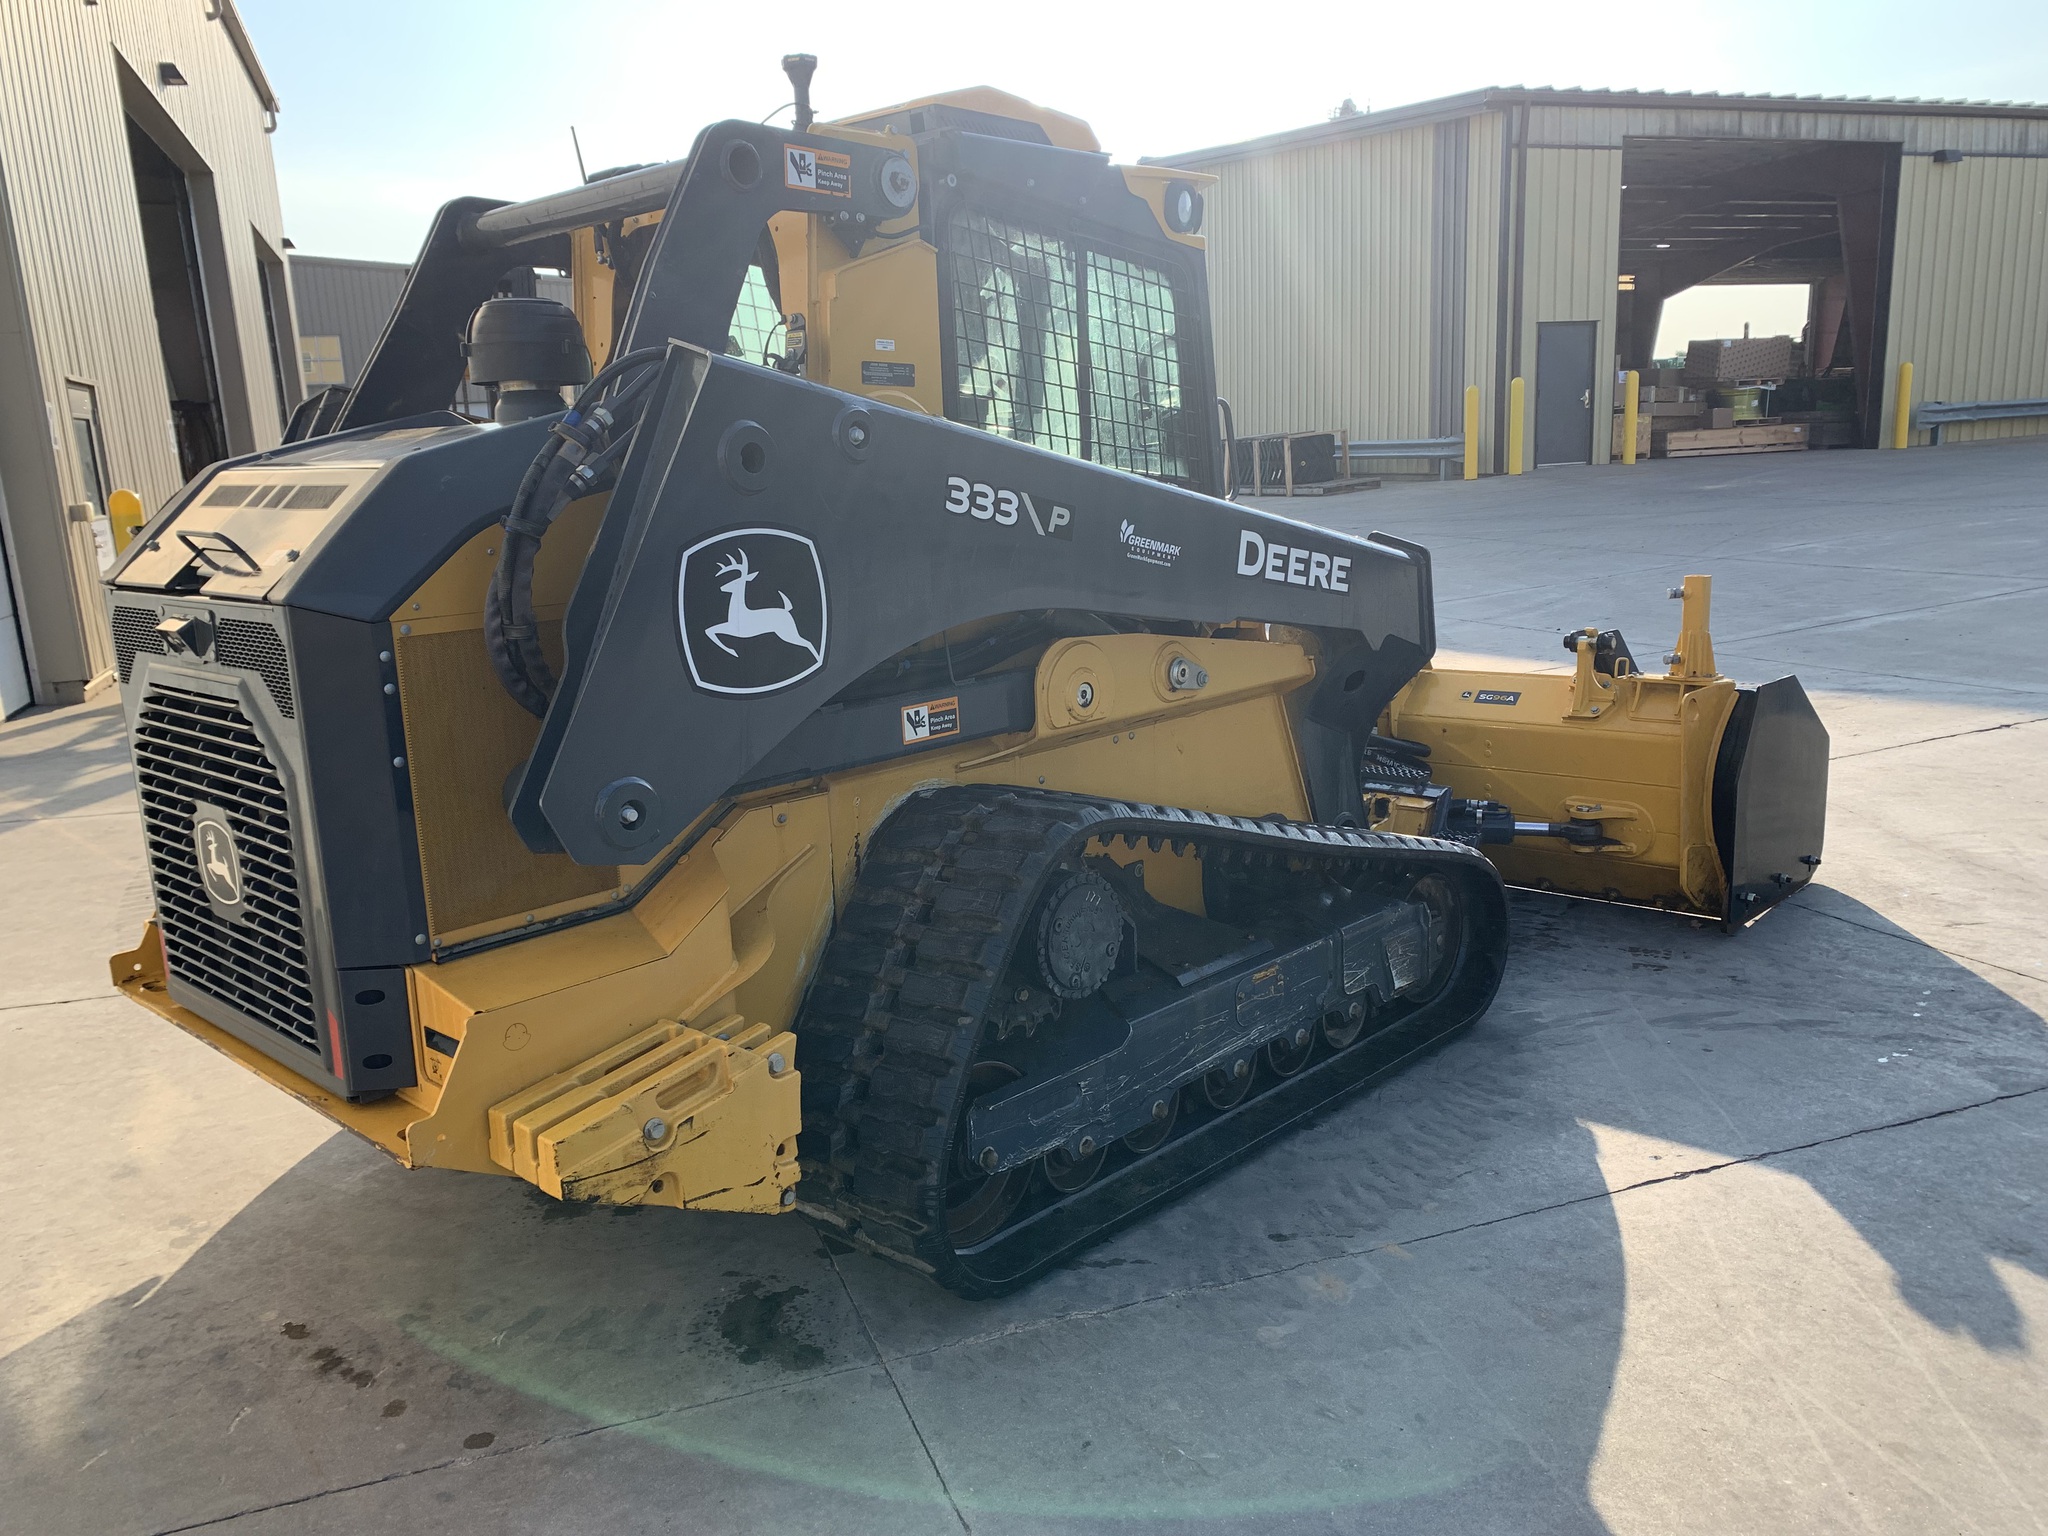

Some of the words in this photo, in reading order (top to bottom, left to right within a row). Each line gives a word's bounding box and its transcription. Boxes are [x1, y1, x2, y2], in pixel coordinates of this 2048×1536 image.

[817, 168, 834, 178] Pinch
[834, 172, 847, 180] Area
[817, 178, 829, 186] Keep
[831, 181, 843, 189] Away
[1128, 535, 1182, 556] GREENMARK
[1131, 546, 1176, 561] EQUIPMENT
[1237, 529, 1352, 592] DEERE
[1478, 693, 1514, 702] SG96A
